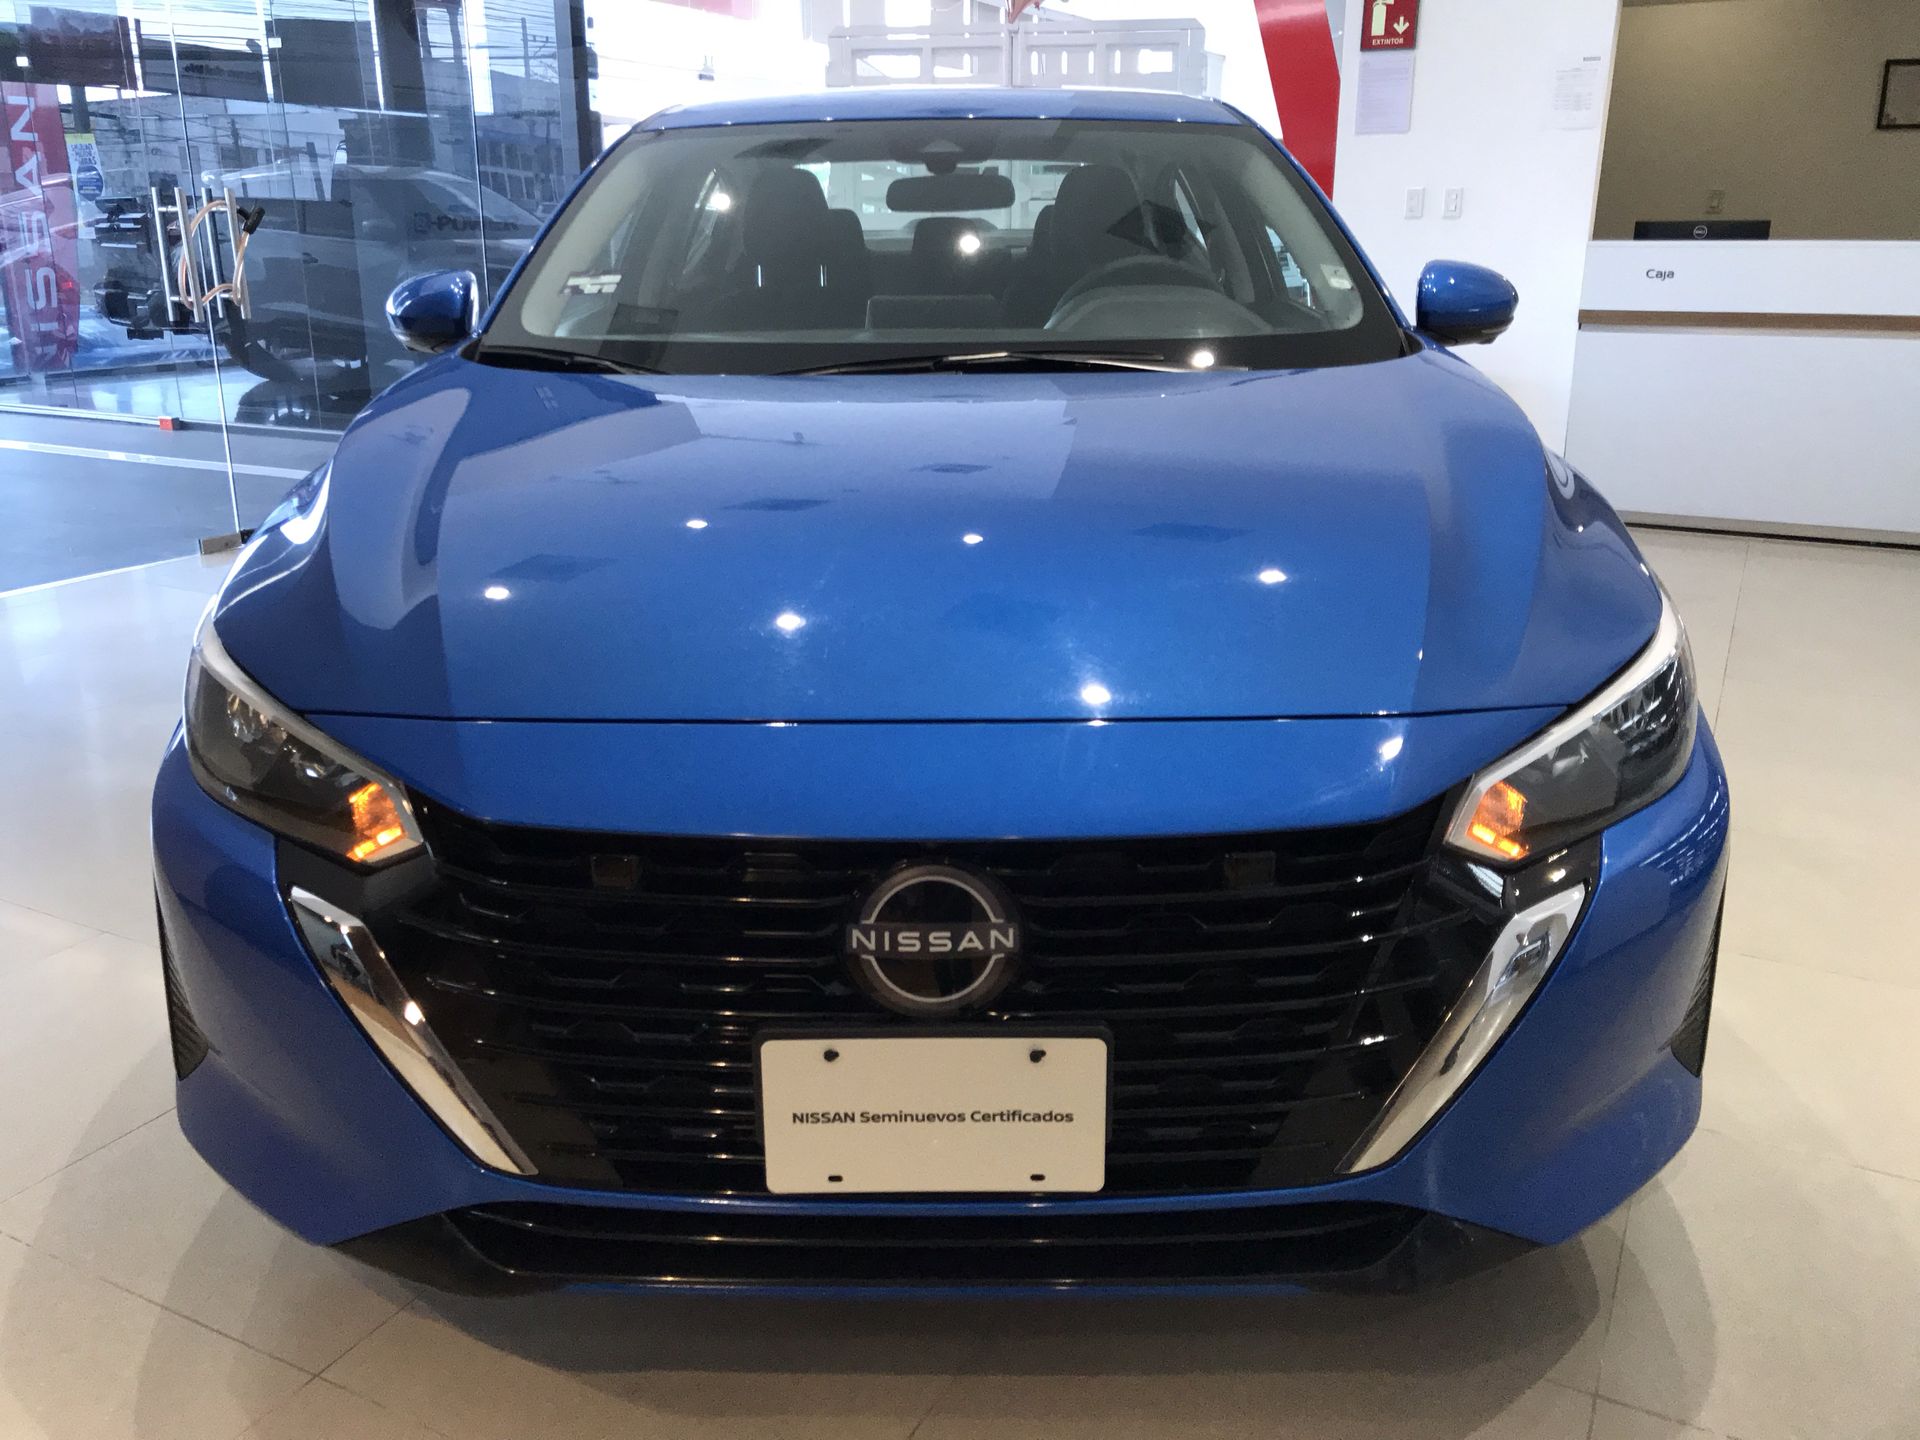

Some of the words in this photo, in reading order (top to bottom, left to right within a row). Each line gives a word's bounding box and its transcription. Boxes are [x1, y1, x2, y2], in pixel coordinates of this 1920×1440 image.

[1372, 38, 1404, 46] EXTINTOR
[1646, 268, 1675, 281] Caja
[852, 928, 1014, 952] NISSAN
[792, 1112, 856, 1124] NISSAN
[860, 1110, 966, 1123] Seminuevos
[970, 1109, 1074, 1123] Certificados
